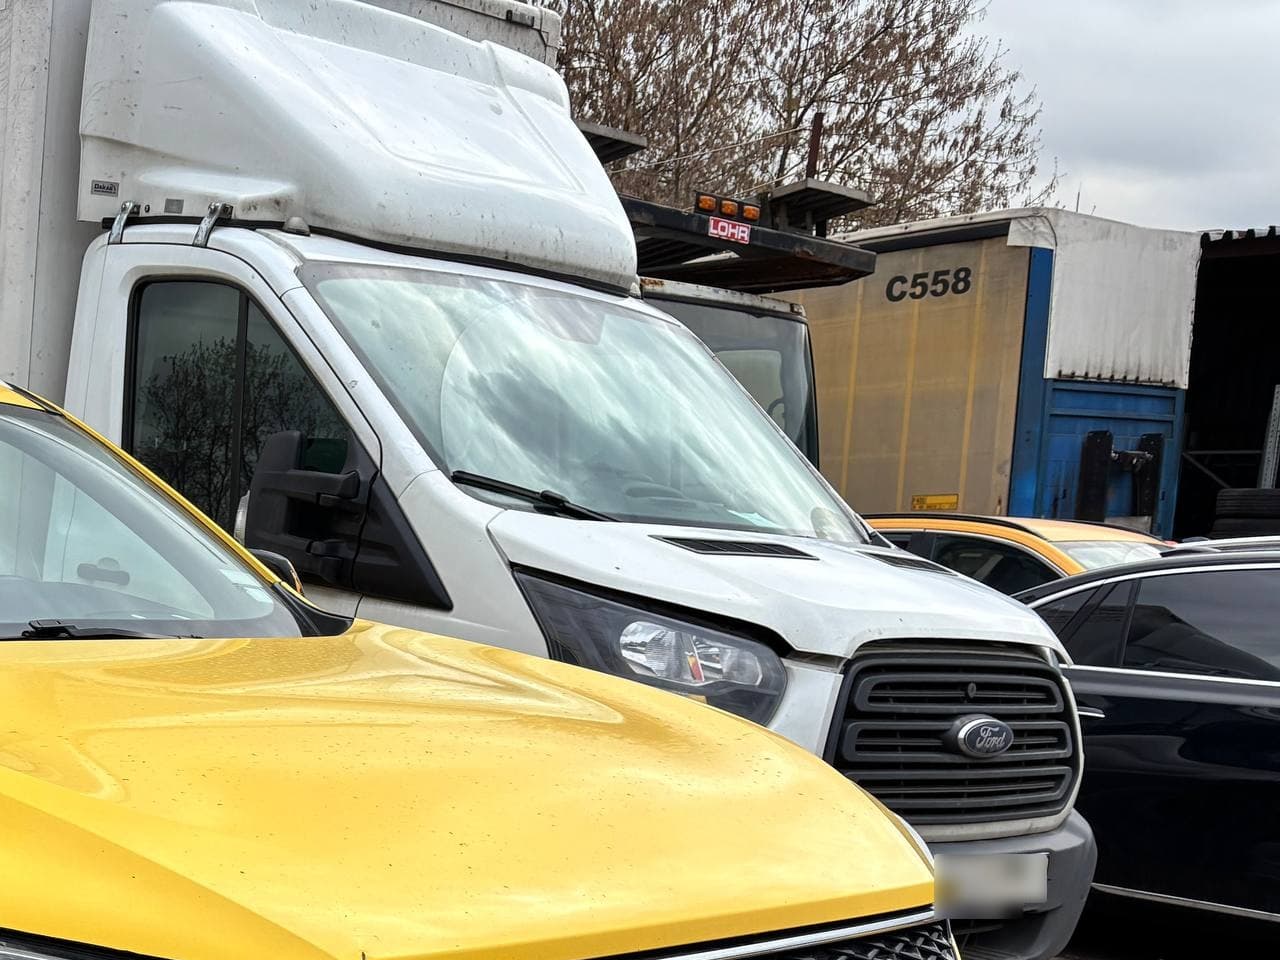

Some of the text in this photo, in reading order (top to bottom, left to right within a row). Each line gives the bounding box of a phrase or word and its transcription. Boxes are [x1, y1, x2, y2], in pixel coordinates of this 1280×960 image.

[710, 220, 748, 240] LOHR
[885, 267, 972, 302] C558
[976, 726, 1007, 749] Ford
